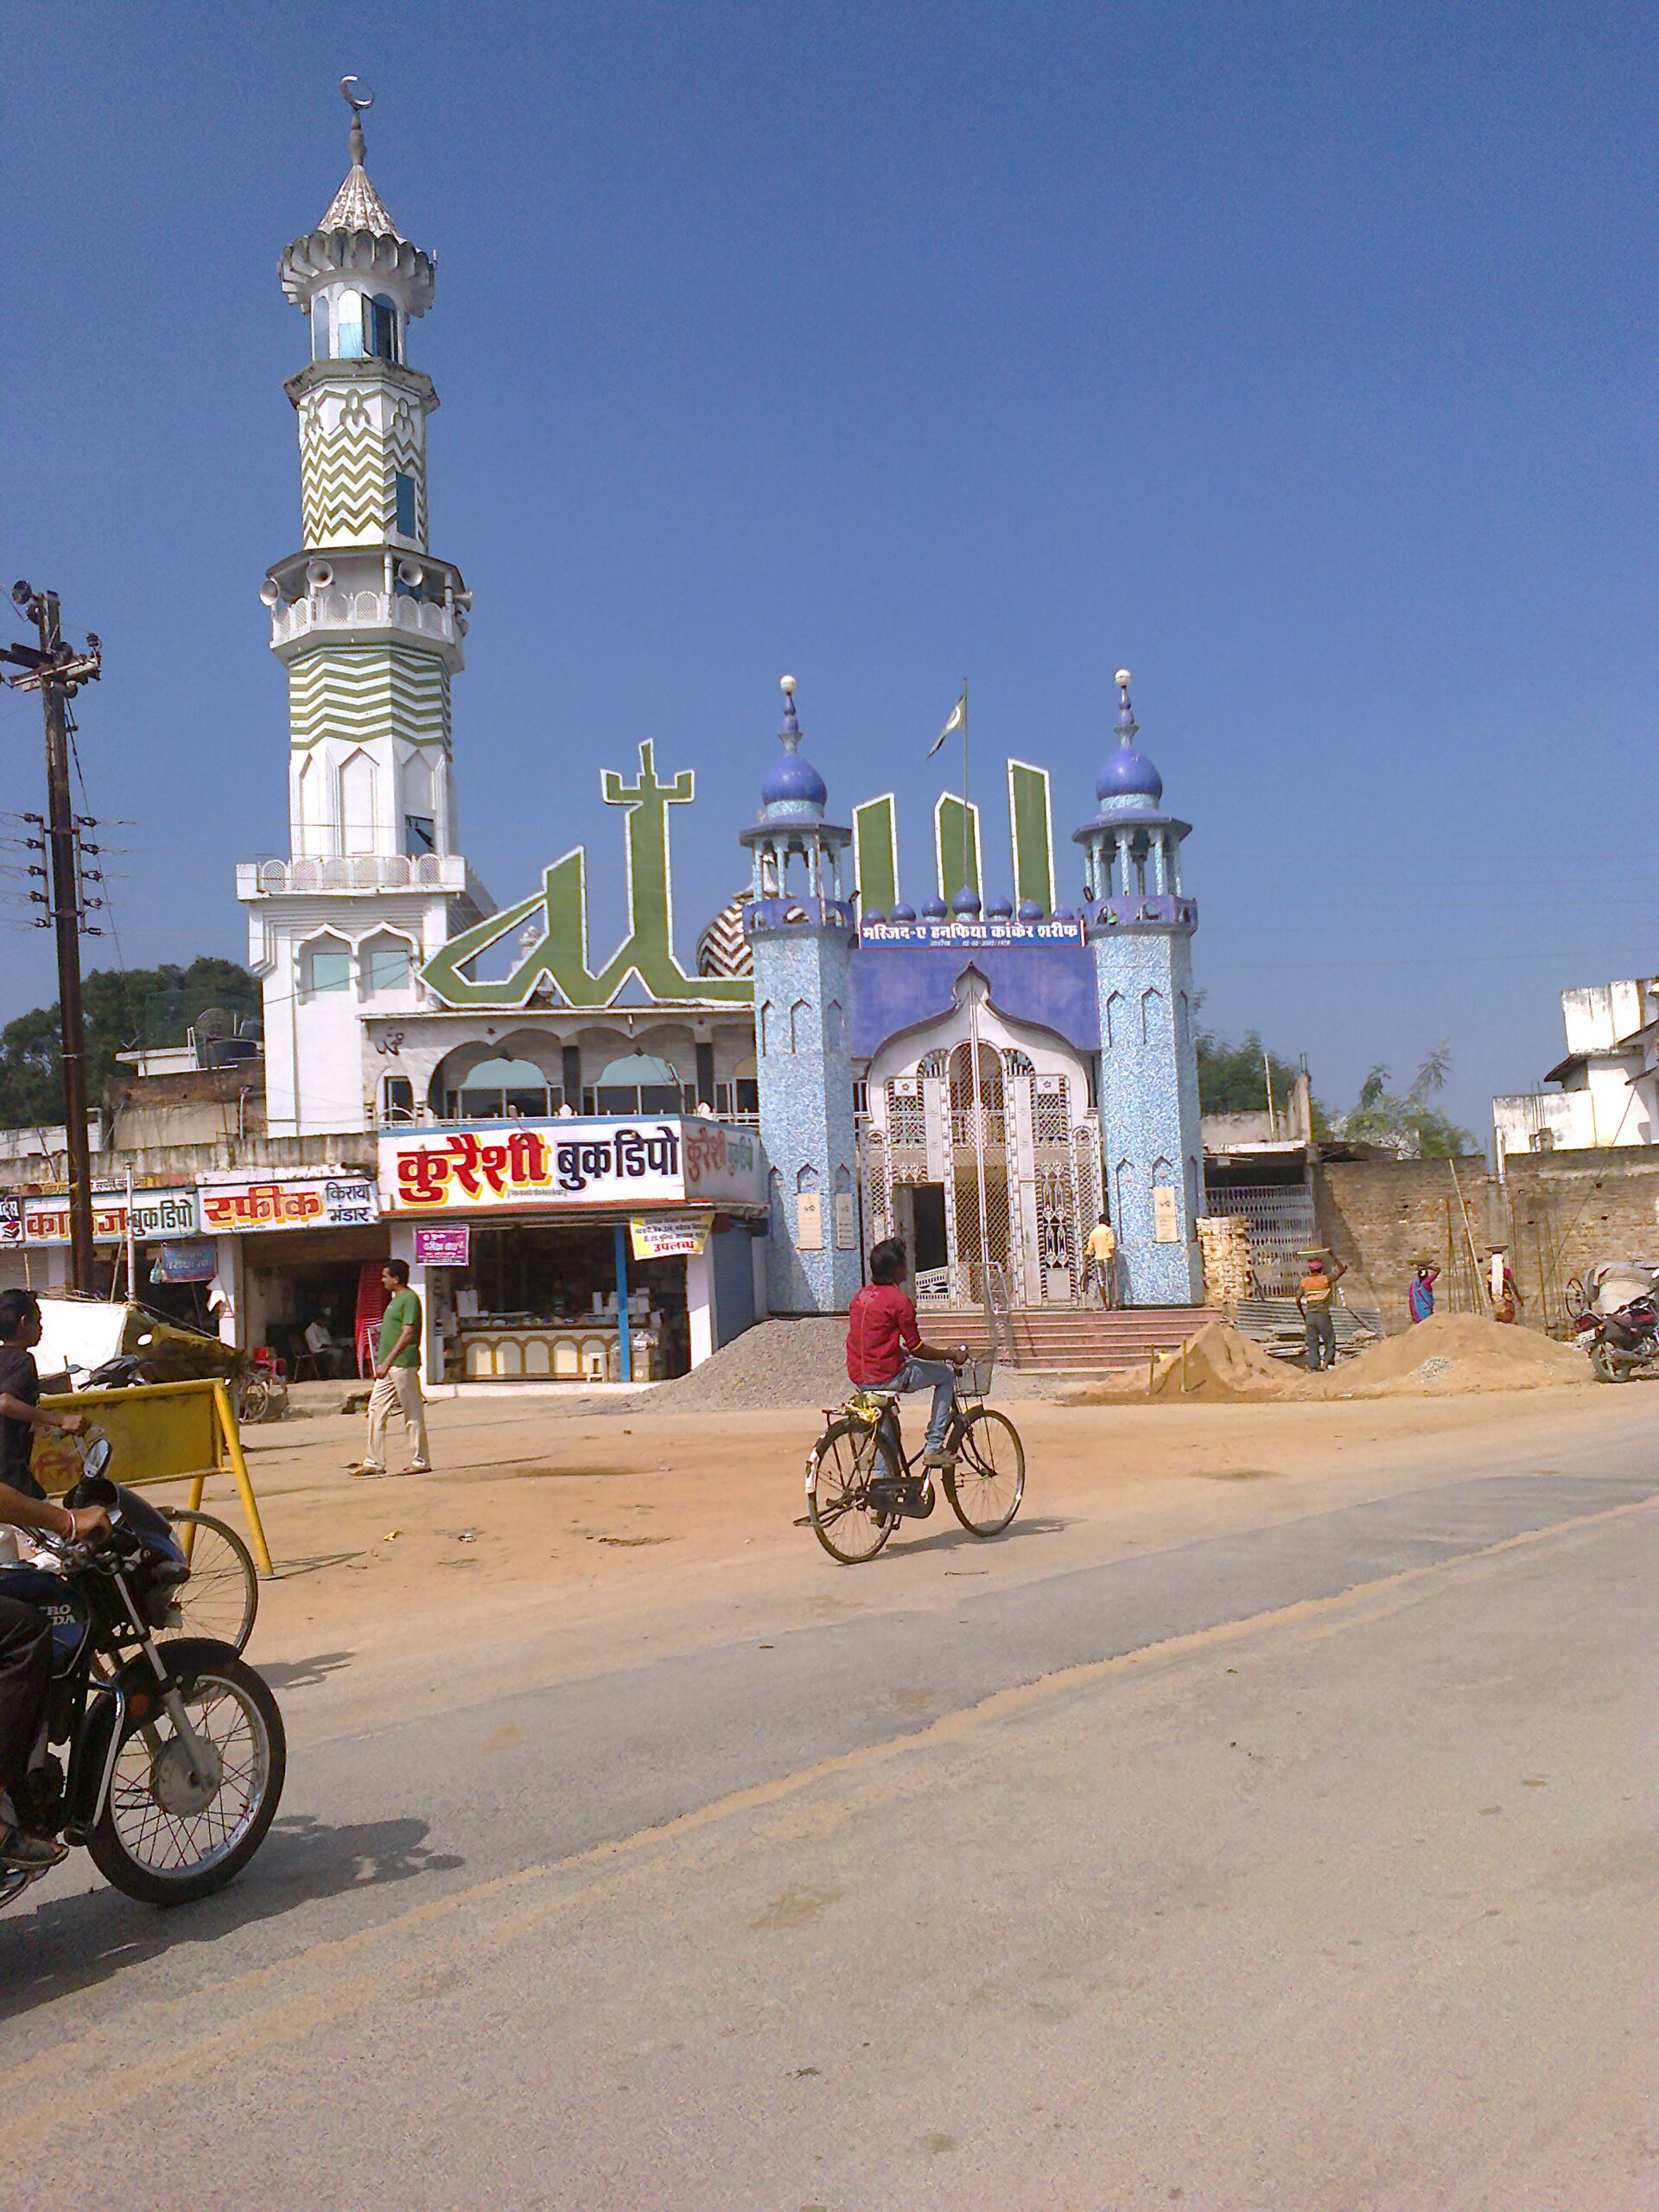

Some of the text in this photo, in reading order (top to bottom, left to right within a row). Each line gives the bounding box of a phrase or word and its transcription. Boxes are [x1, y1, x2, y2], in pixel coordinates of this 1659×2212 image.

[930, 923, 988, 939] हनफिया
[990, 922, 1035, 939] कांकेर
[1036, 921, 1078, 938] शरीफ
[397, 1126, 679, 1205] कुरैशी बुक डिपो
[325, 1181, 372, 1202] किराया
